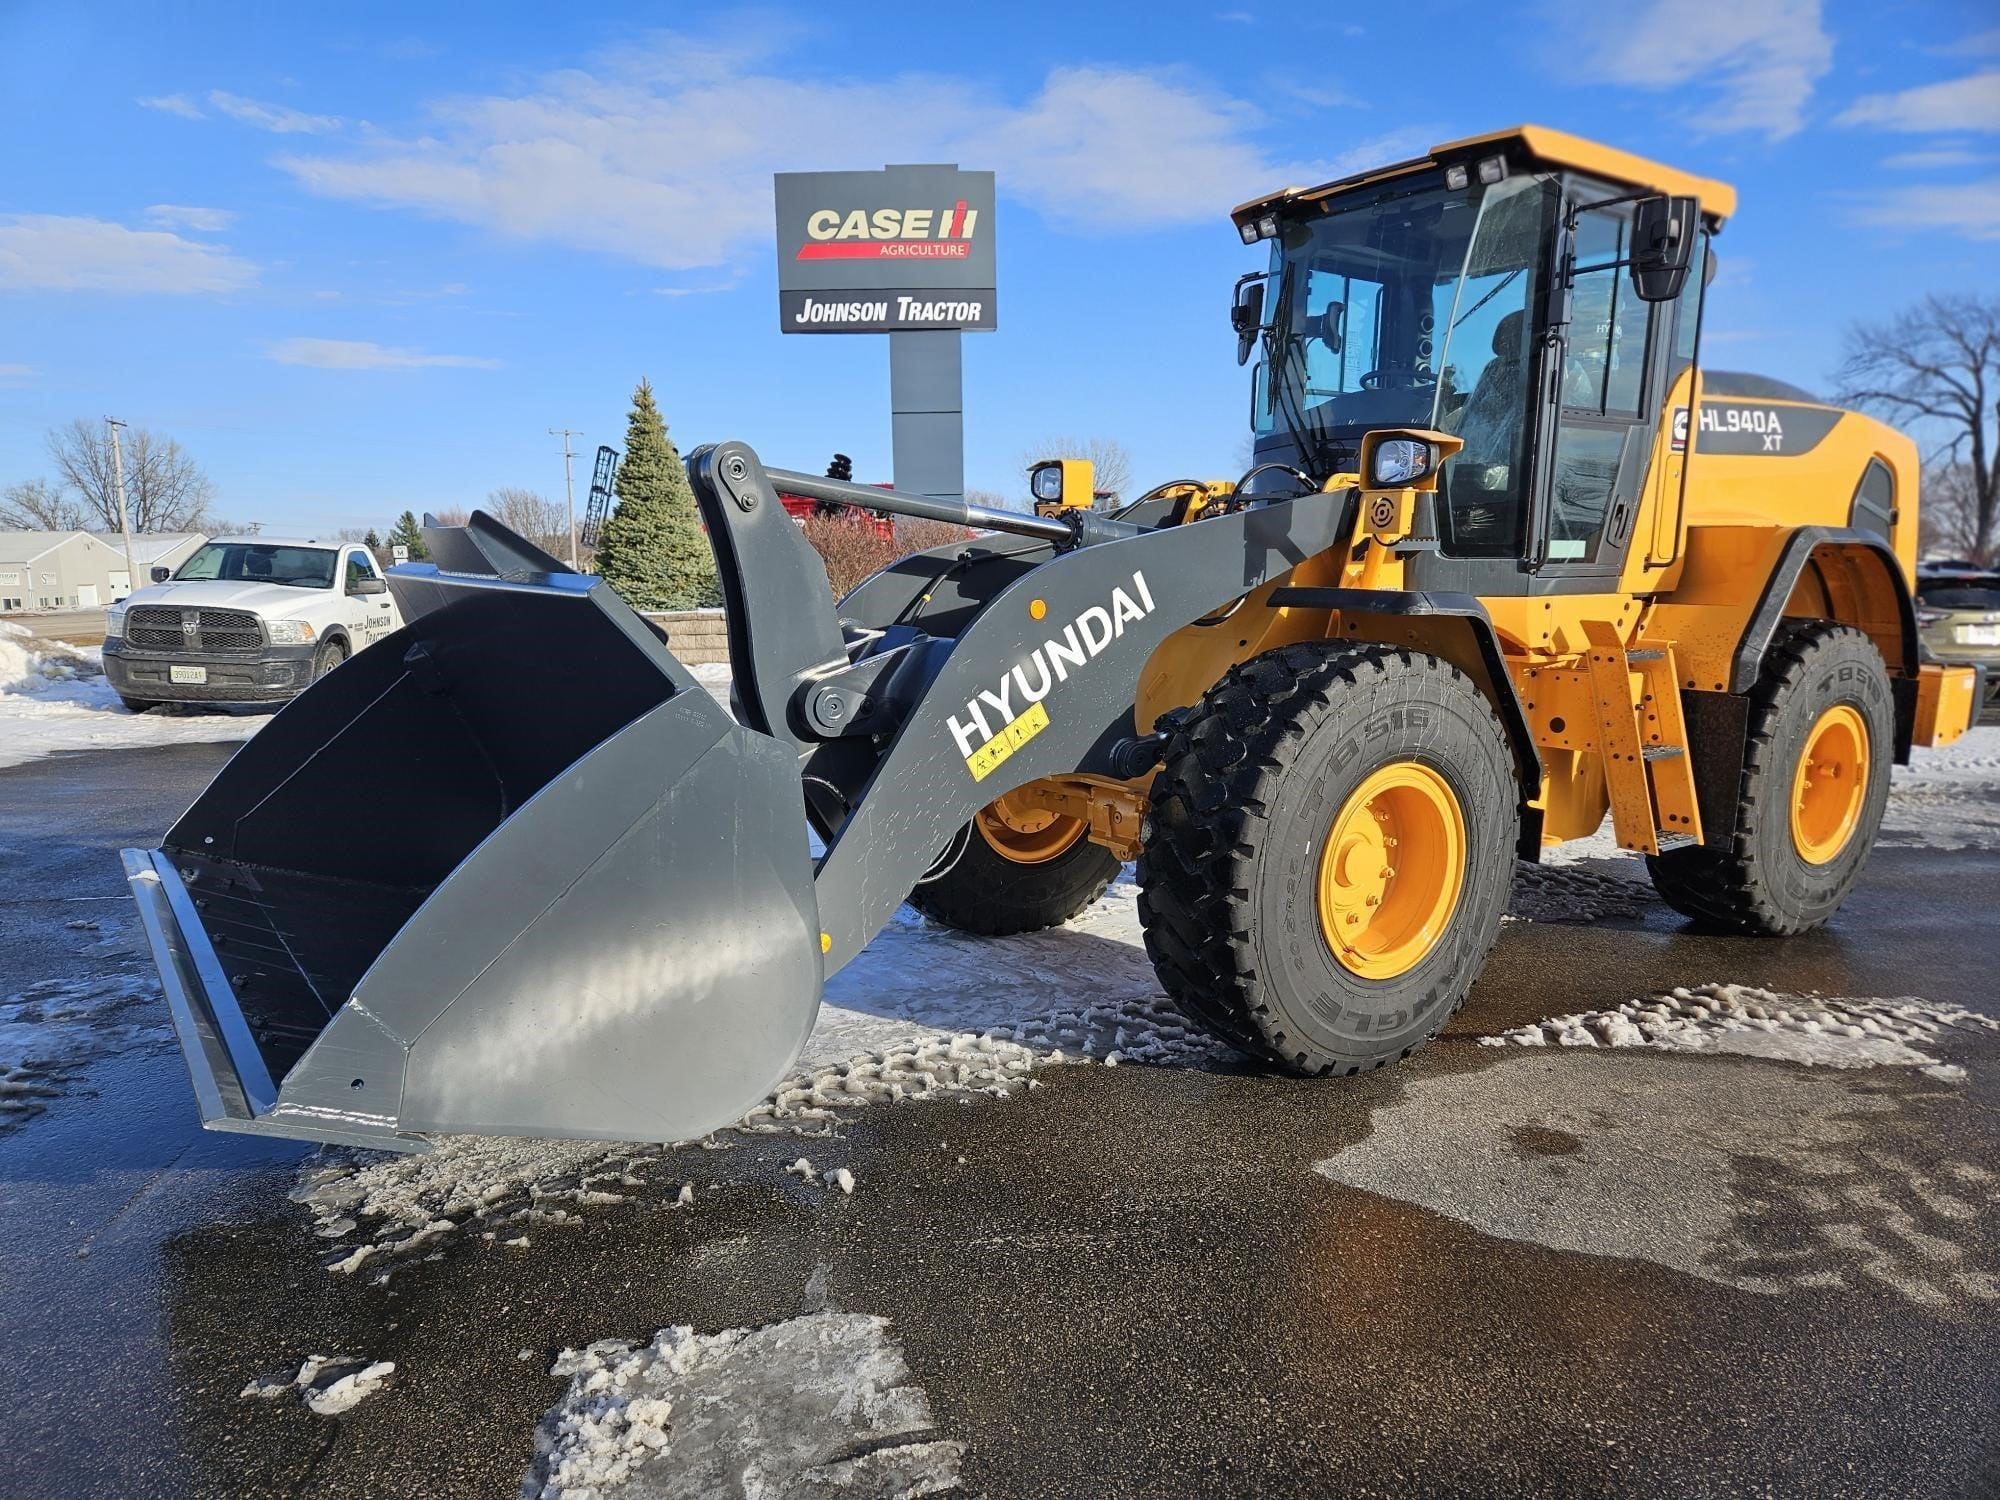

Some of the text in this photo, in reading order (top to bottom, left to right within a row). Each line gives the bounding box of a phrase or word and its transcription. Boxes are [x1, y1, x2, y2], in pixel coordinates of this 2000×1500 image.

[807, 208, 934, 240] CASE
[880, 244, 965, 256] AGRICULTURE
[796, 296, 982, 324] JOHNSON TRACTOR
[1697, 408, 1783, 434] HL940A
[1763, 434, 1783, 451] XT
[364, 614, 391, 630] JOHNSON
[946, 570, 1156, 760] HYUNDAI
